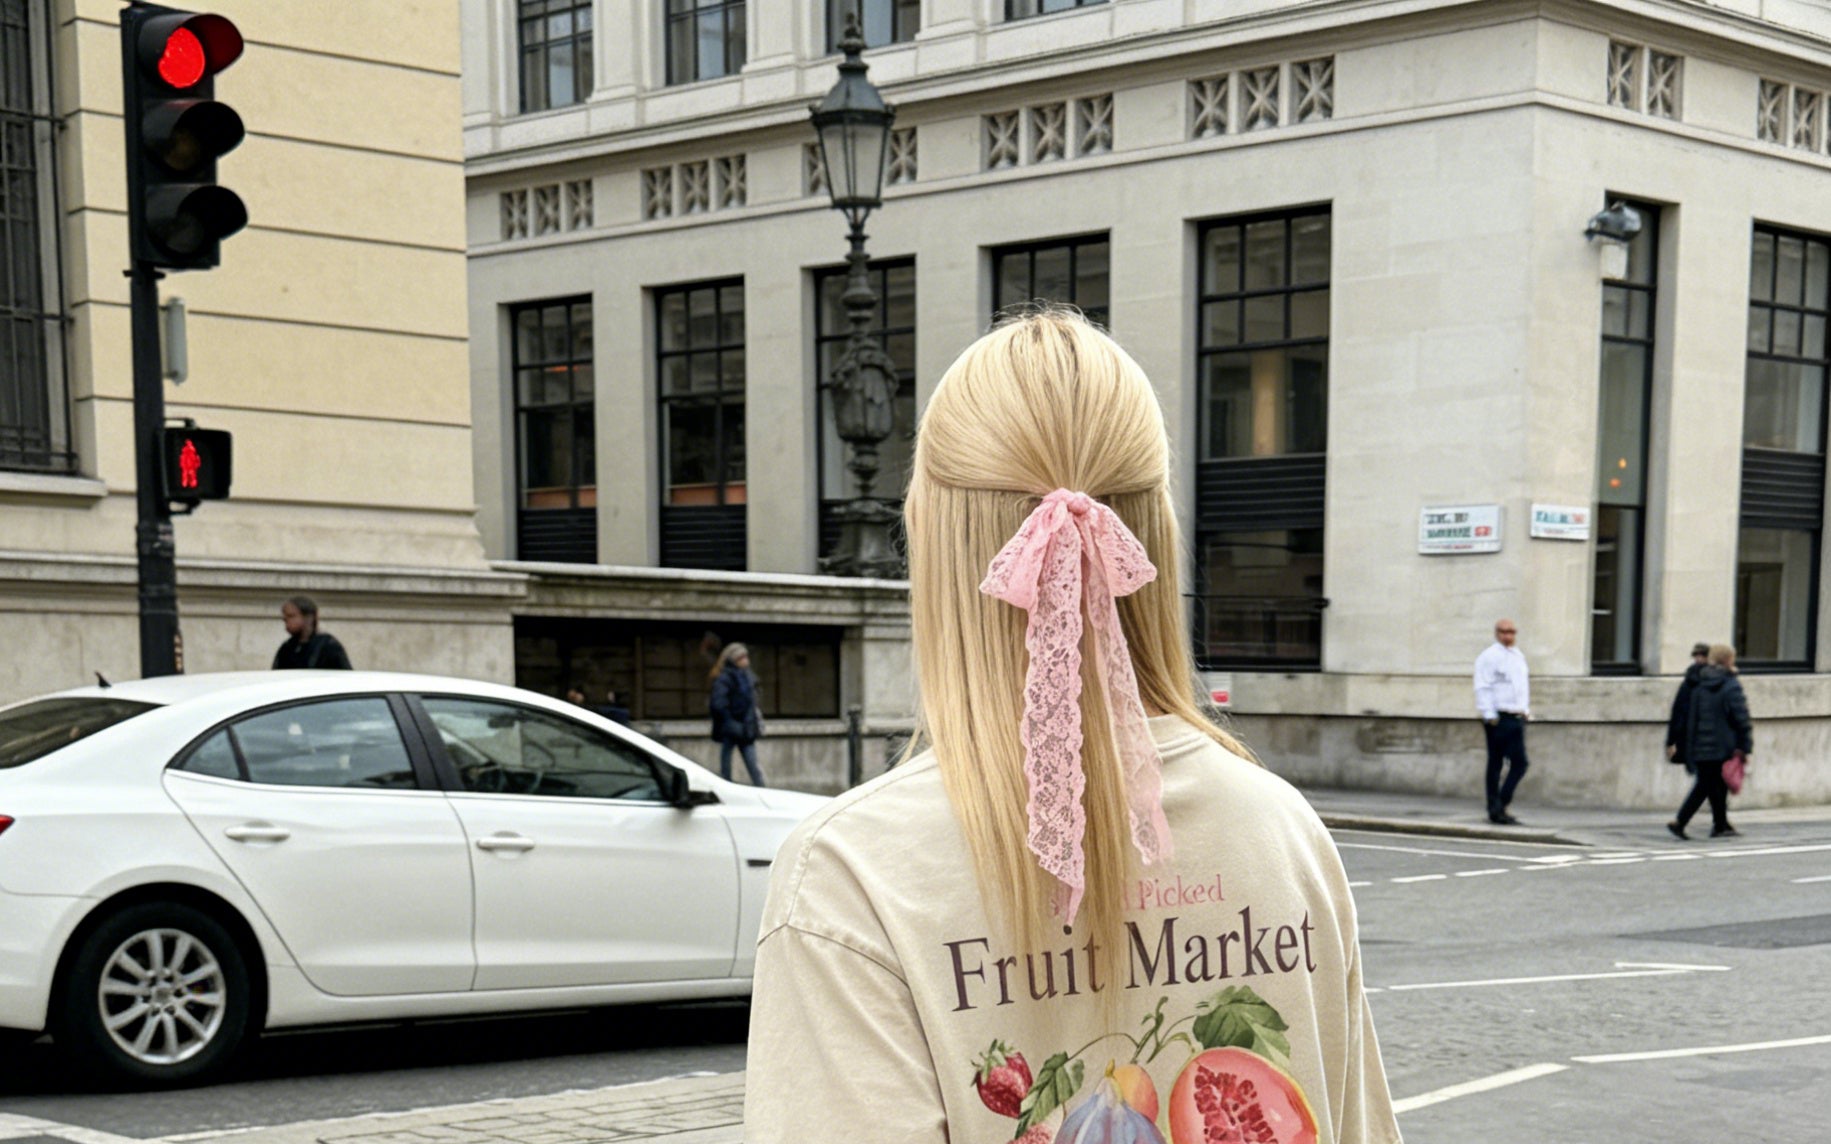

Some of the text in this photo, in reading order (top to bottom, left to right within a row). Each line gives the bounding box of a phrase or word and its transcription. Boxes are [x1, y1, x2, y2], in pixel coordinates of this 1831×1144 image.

[1138, 873, 1225, 911] Picked
[943, 905, 1318, 1012] Fruit Market
